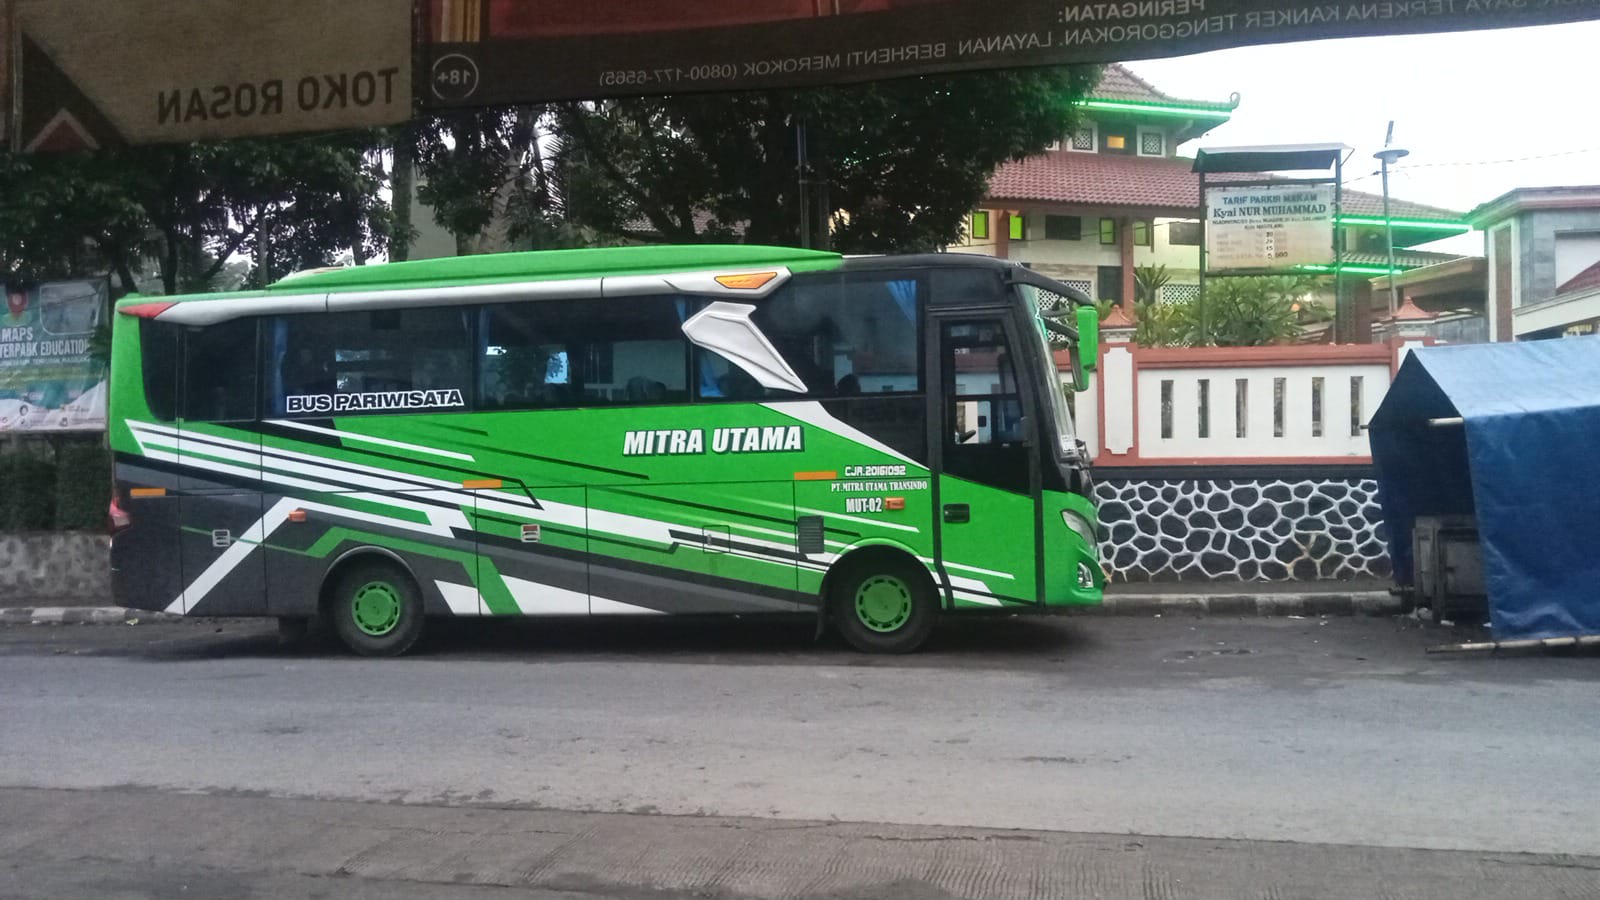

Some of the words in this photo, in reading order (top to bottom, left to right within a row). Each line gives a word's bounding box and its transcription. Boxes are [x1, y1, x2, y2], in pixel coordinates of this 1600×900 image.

[1223, 195, 1249, 205] TARIF
[1250, 194, 1281, 204] PARKIR
[1239, 206, 1261, 217] NUR
[1262, 204, 1327, 216] MUHAMMAD
[1, 327, 33, 342] MAPS
[287, 395, 332, 412] BUS
[334, 389, 464, 411] PARIWISATA
[623, 429, 704, 456] MITRA
[711, 426, 803, 453] UTAMA
[866, 481, 888, 491] UTAMA
[889, 481, 928, 491] TRANSINDO
[846, 498, 882, 513] MUT-02
